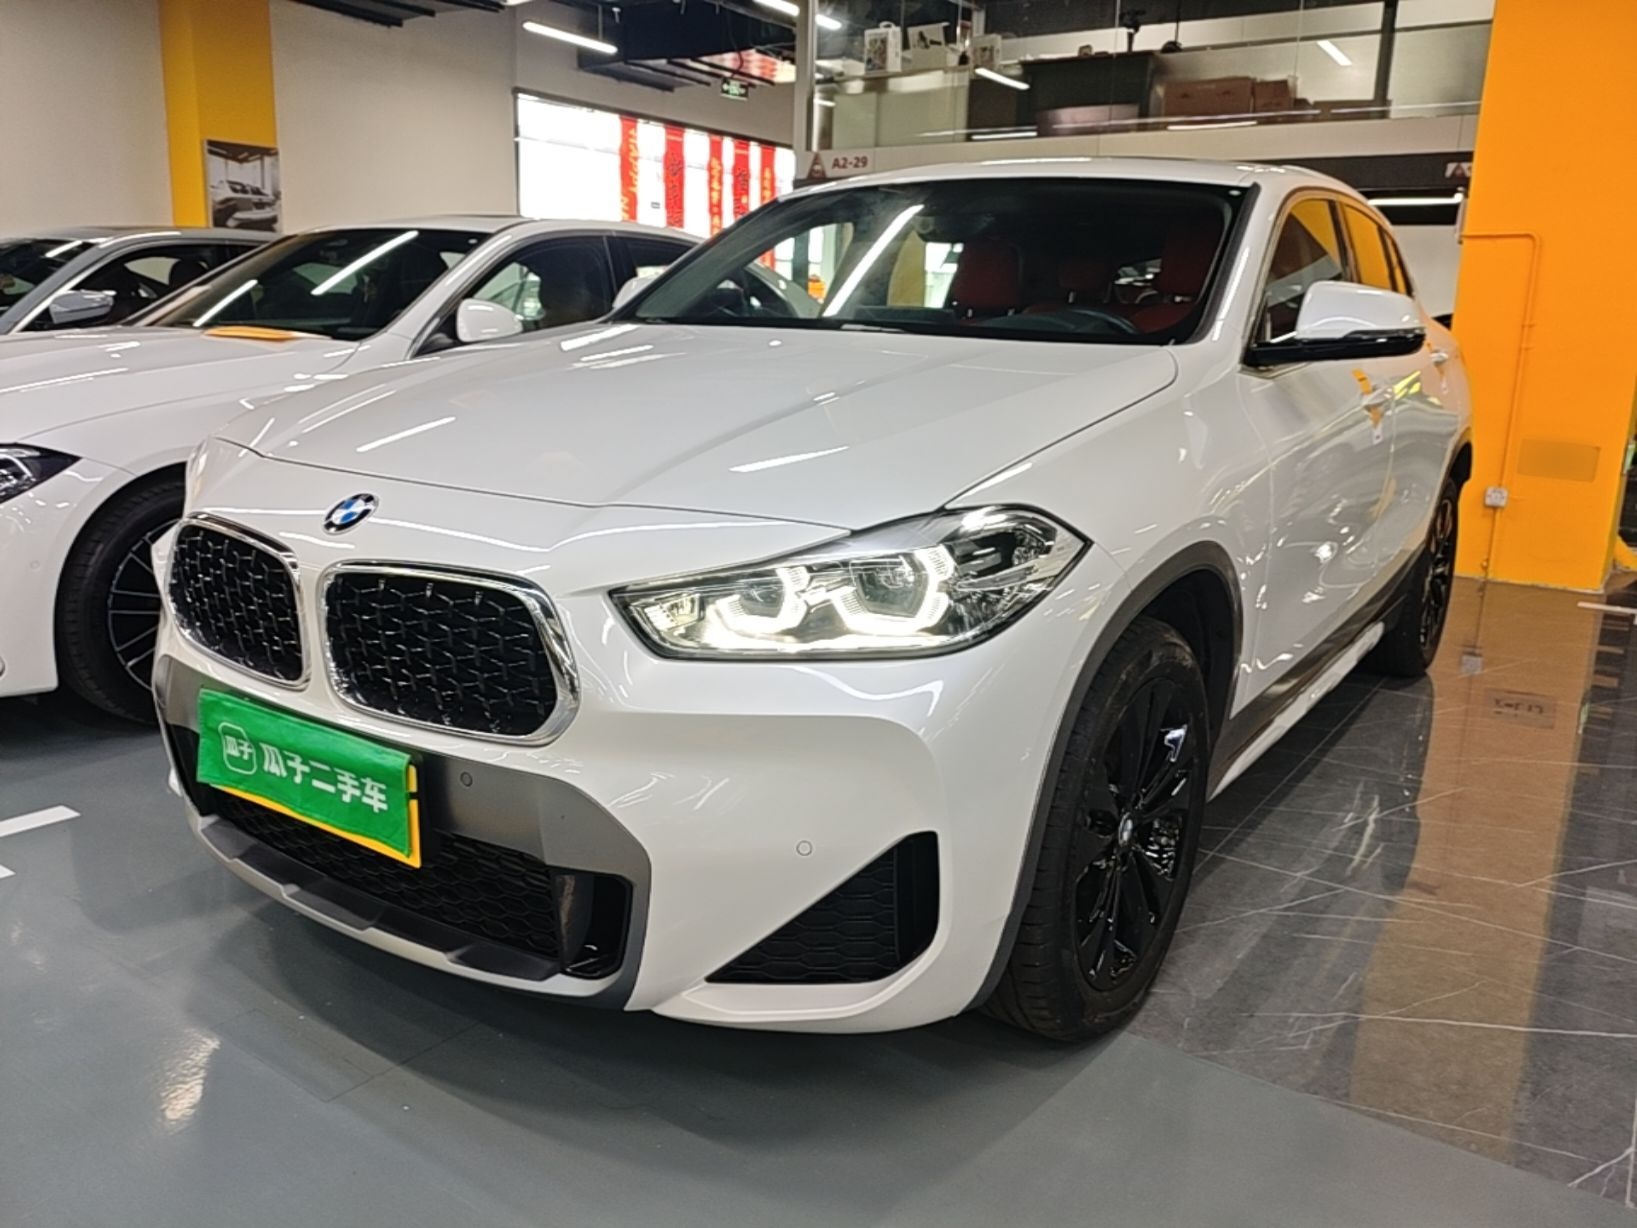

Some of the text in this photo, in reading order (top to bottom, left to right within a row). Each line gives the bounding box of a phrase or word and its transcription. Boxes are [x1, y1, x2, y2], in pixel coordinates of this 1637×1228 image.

[832, 156, 868, 169] A2-29
[224, 735, 253, 760] 瓜子
[260, 742, 389, 813] 瓜子二手车
